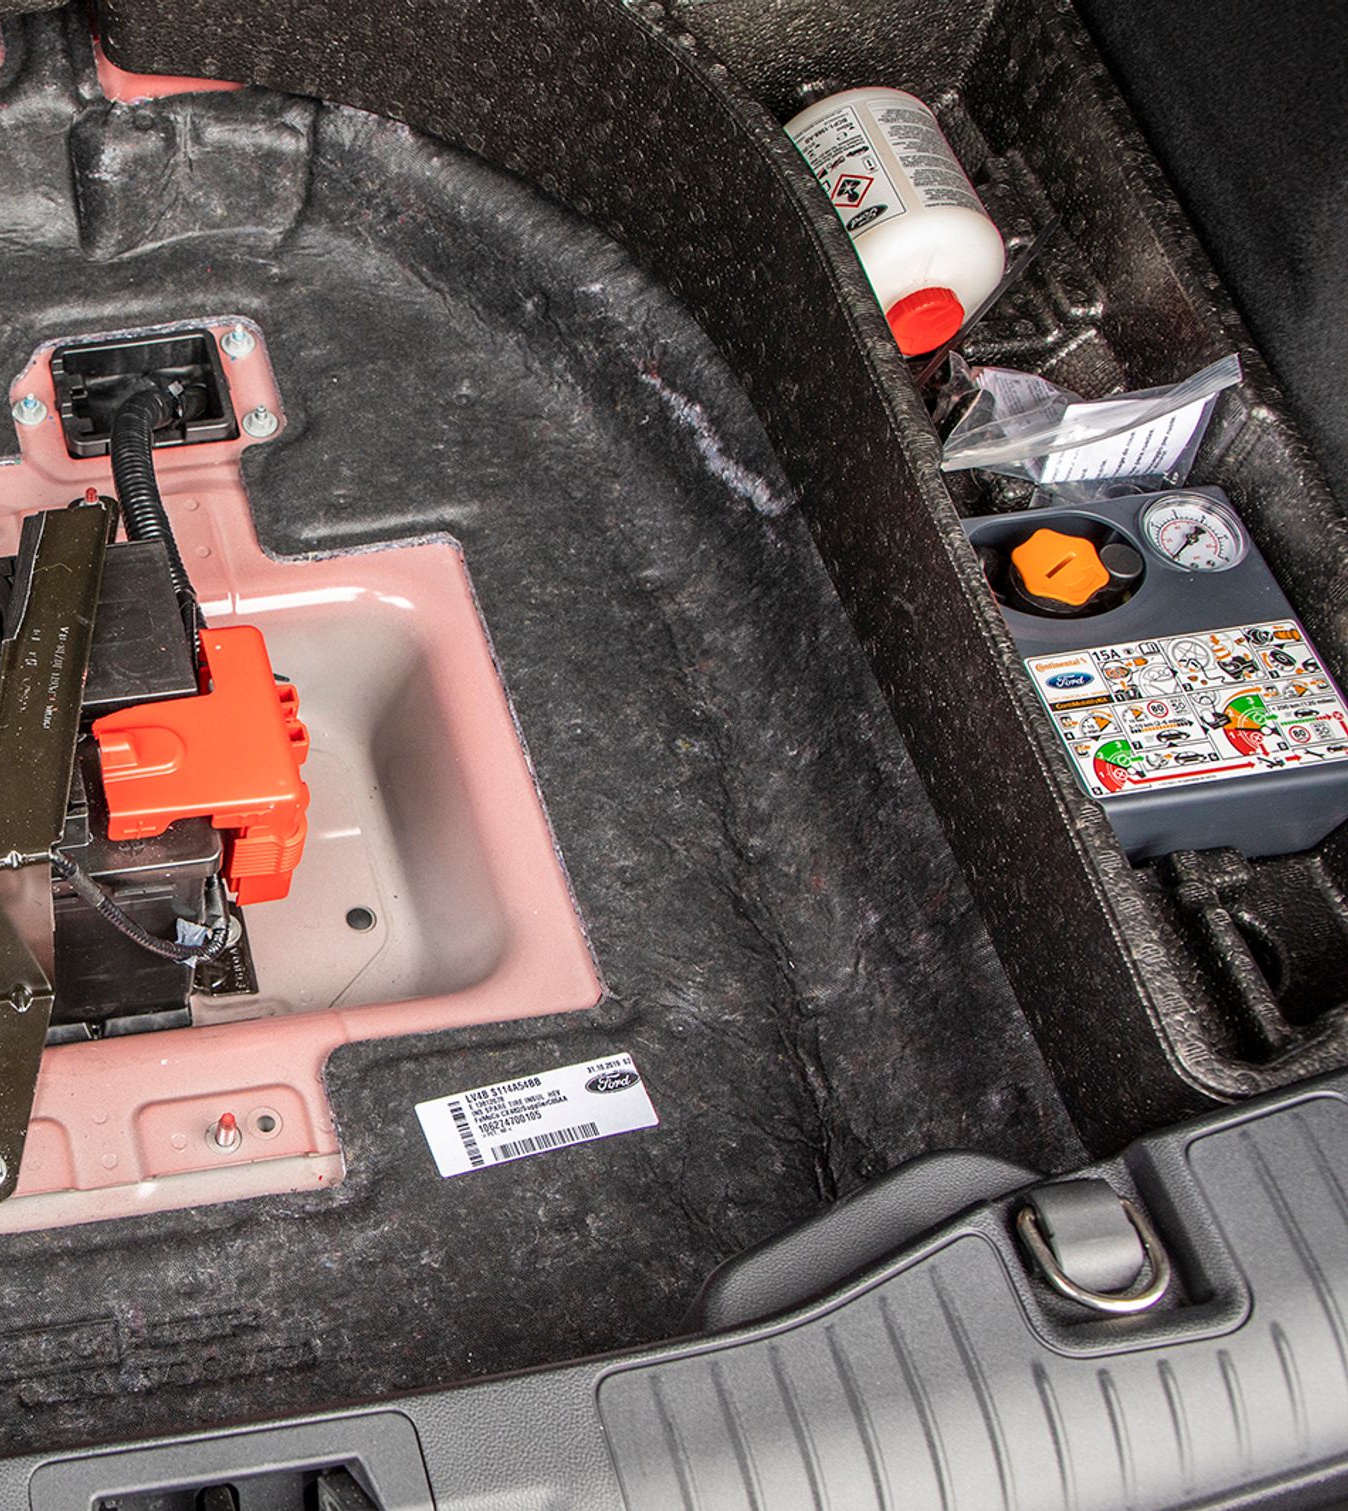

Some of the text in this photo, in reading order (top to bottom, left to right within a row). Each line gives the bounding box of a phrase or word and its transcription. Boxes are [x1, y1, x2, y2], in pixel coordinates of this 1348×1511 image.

[1092, 648, 1120, 661] 15A
[1035, 659, 1080, 673] Continental
[465, 1090, 489, 1104] LV4B
